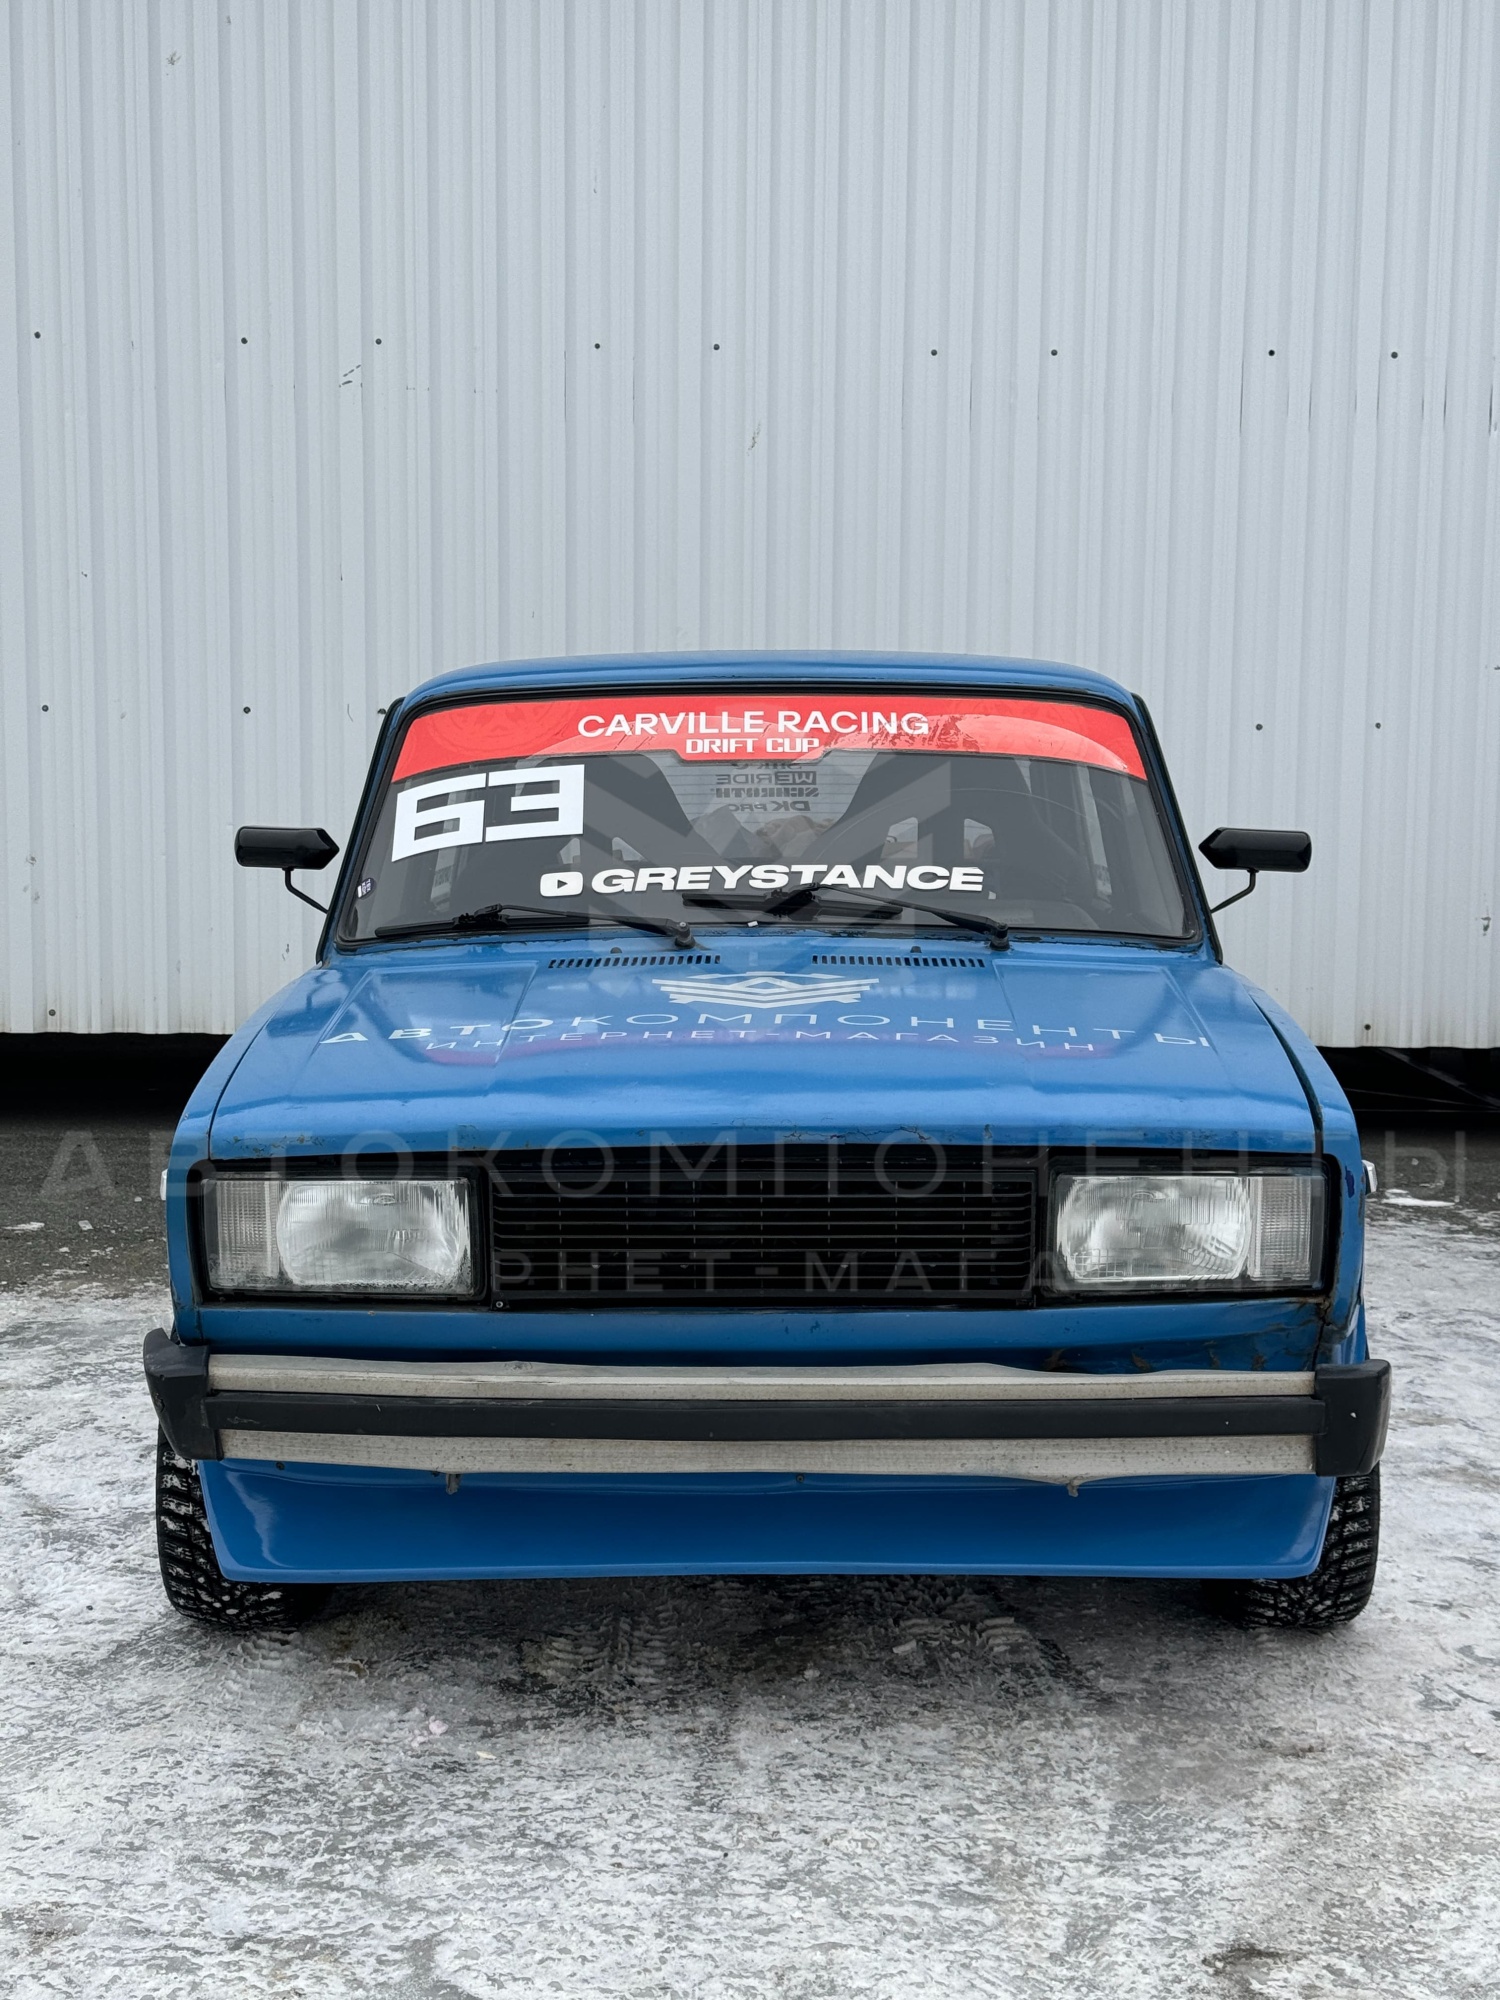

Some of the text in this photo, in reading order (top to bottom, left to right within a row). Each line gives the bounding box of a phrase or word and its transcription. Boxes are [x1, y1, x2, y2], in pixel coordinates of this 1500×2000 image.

[578, 711, 928, 738] CARVILLE RACING
[685, 738, 820, 754] DRIFT CUP
[391, 764, 585, 862] 63
[591, 864, 985, 893] GREYSTANCE
[318, 1013, 1210, 1048] АВТОКОМПОНЕНТЫ
[425, 1030, 1095, 1052] ИНТЕРНЕТ-МАГАЗИН
